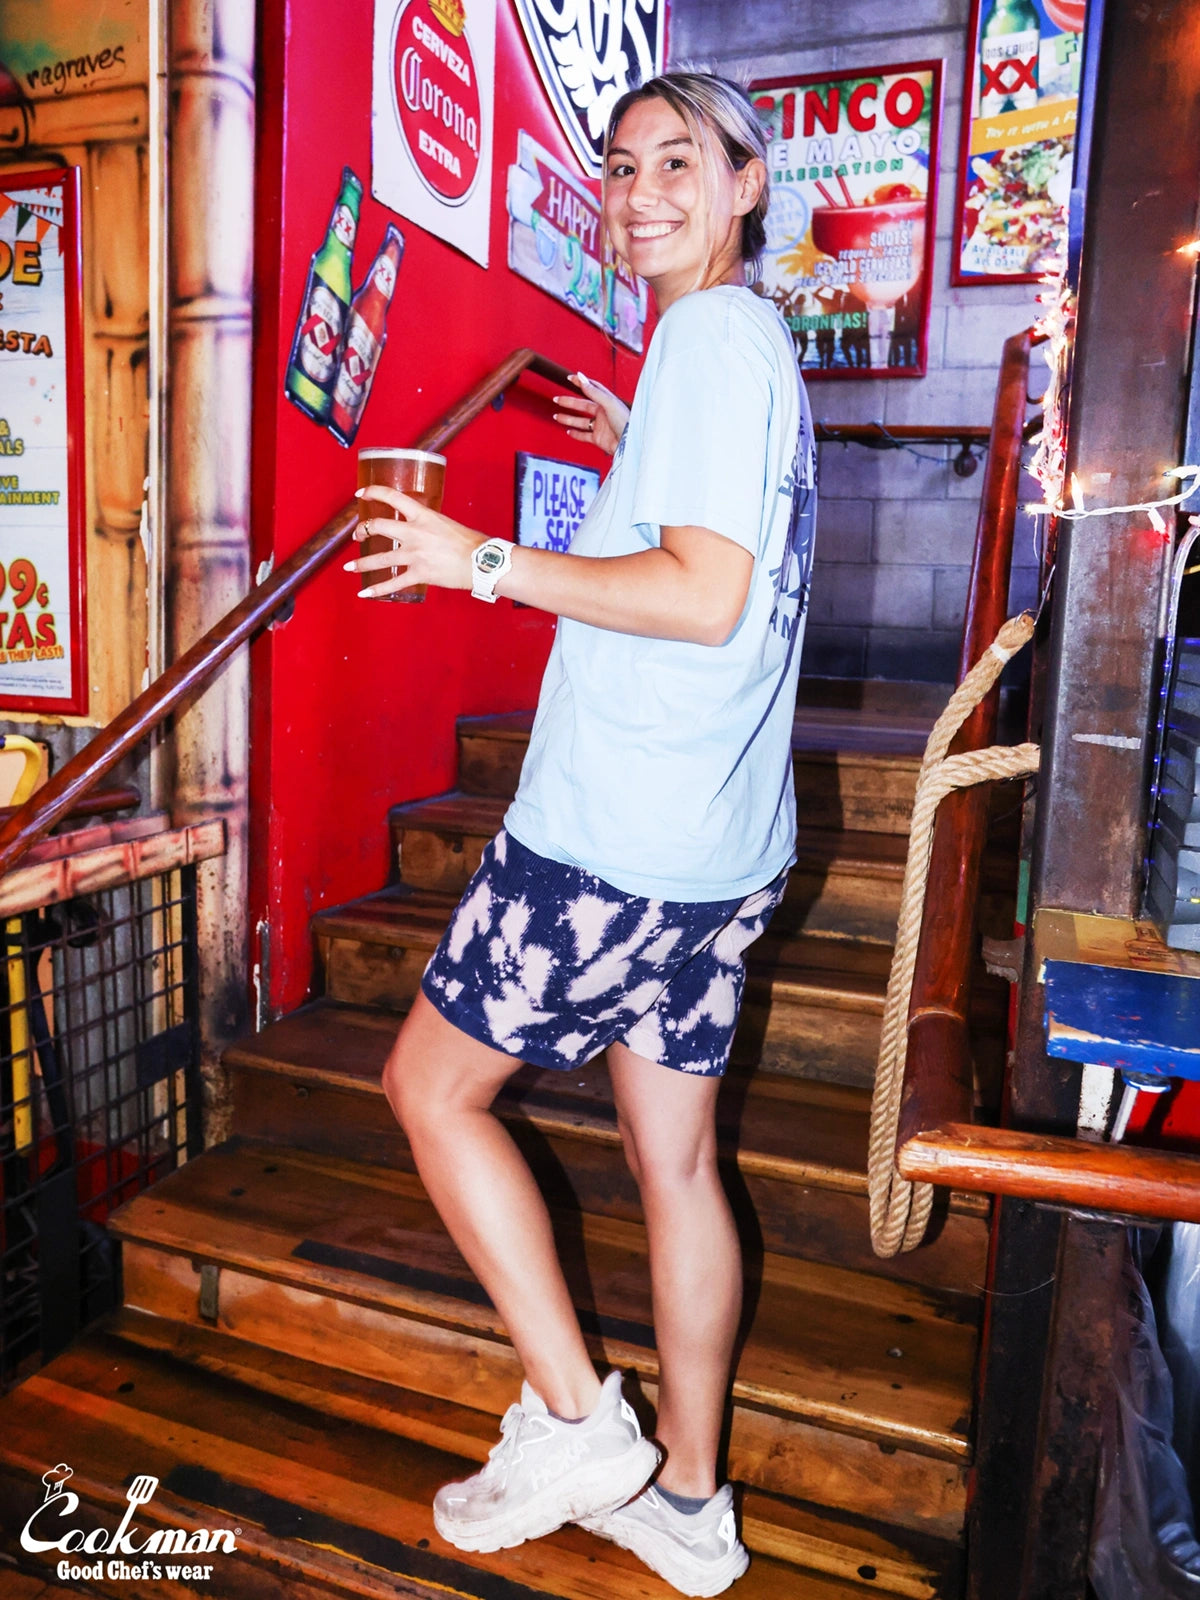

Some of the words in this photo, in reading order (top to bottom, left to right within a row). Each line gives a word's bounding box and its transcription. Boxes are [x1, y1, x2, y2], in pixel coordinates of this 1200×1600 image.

[412, 16, 471, 87] CERVEZA
[401, 47, 480, 160] Corona
[418, 129, 462, 179] EXTRA
[805, 129, 922, 165] MAYO
[545, 176, 599, 251] HAPPY
[533, 470, 587, 519] PLEASE
